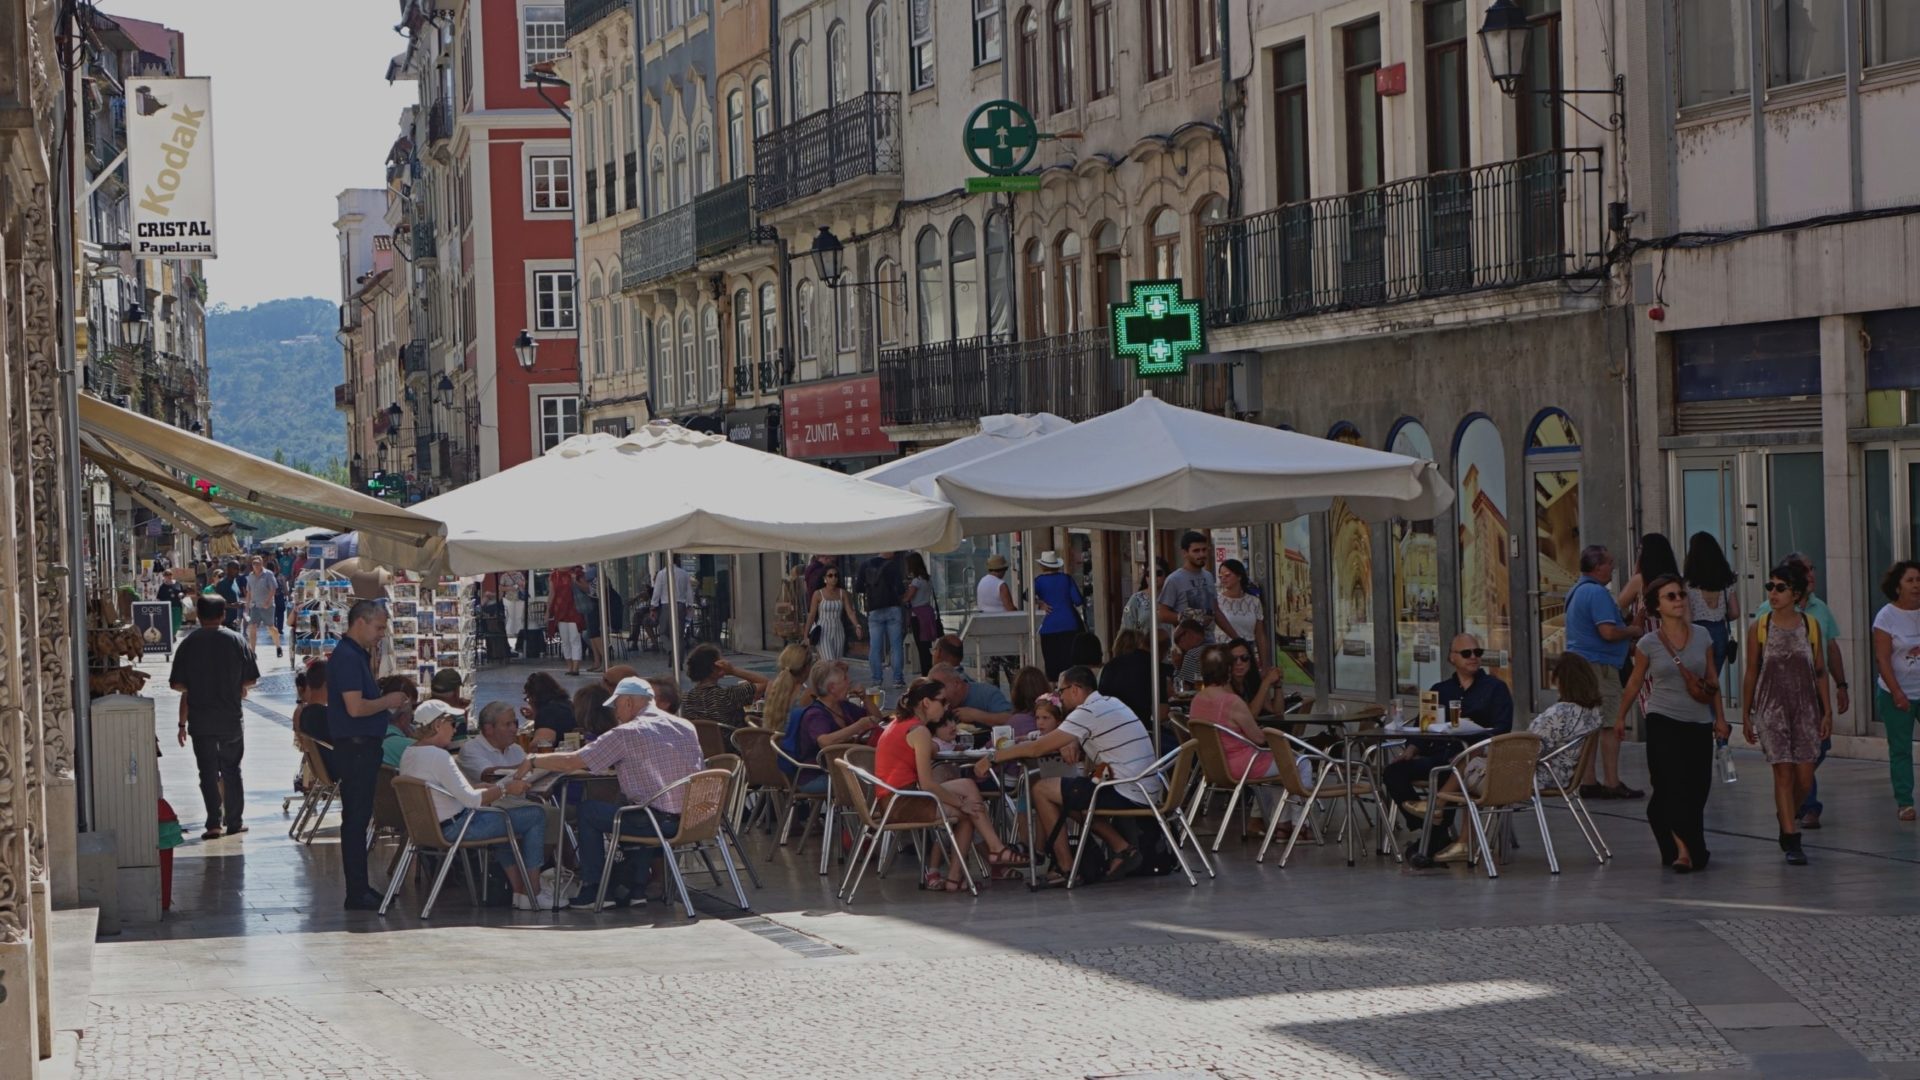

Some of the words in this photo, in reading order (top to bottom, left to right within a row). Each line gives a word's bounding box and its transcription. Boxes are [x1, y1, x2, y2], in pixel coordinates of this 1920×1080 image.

[139, 104, 205, 217] Kodak
[137, 221, 211, 238] CRISTAL
[139, 241, 212, 255] Papelaria
[804, 422, 839, 443] ZUNITA
